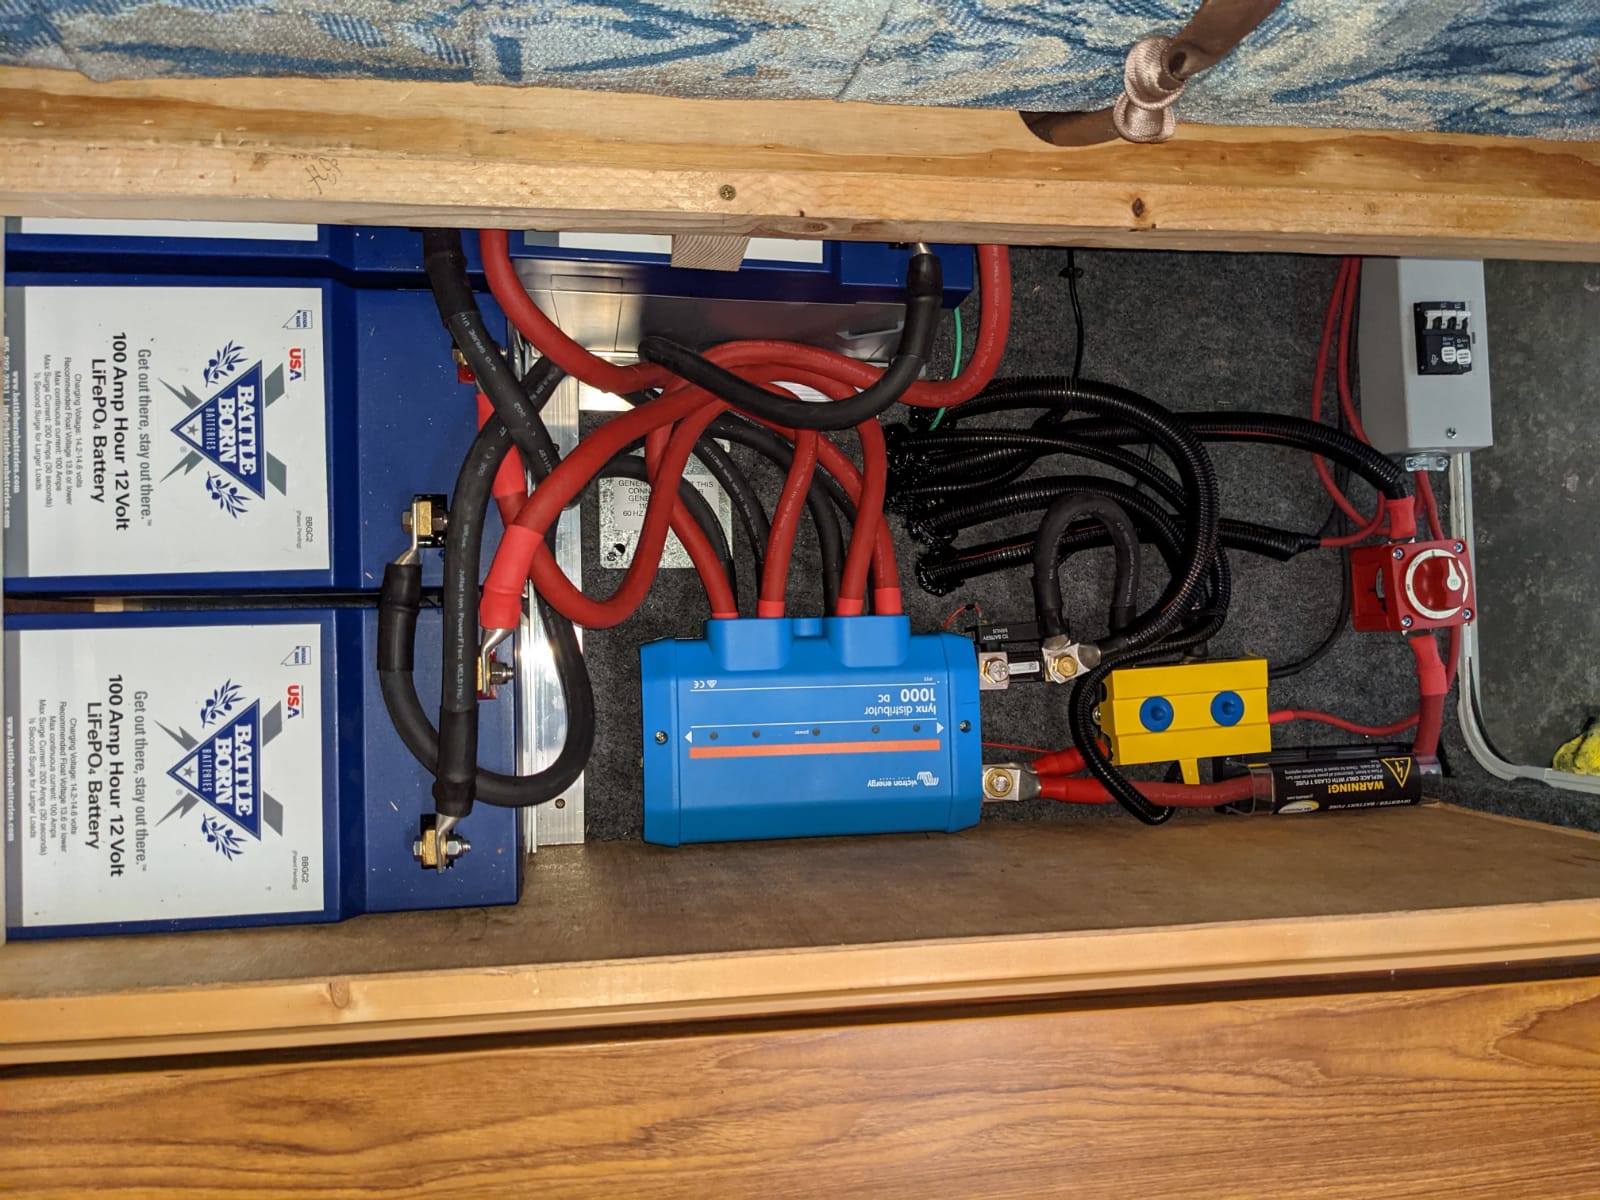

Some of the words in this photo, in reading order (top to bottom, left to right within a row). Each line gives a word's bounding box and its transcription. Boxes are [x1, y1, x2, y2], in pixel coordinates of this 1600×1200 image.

[113, 332, 126, 362] 100
[138, 349, 151, 370] Get
[290, 348, 301, 381] USA
[43, 372, 51, 392] Surge
[110, 367, 127, 411] Amp
[138, 374, 150, 392] out
[33, 410, 41, 430] Surge
[138, 396, 152, 430] there,
[115, 418, 128, 463] Hour
[206, 408, 216, 450] BATTERIES
[219, 397, 236, 463] BORN
[238, 385, 256, 475] BATTLE
[34, 444, 42, 466] Larger
[43, 440, 52, 460] Amps
[64, 433, 72, 457] Voltage
[137, 434, 152, 458] stay
[54, 471, 62, 491] Amps
[91, 436, 106, 503] Battery
[115, 470, 129, 490] 12
[140, 462, 152, 481] out
[116, 493, 130, 530] Volt
[109, 674, 123, 705] 100
[134, 691, 148, 712] Get
[288, 685, 299, 718] USA
[901, 688, 936, 702] 1000
[864, 705, 912, 717] distributor
[916, 703, 936, 715] lynx
[38, 717, 46, 737] Surge
[59, 702, 67, 755] Recommended
[69, 718, 77, 750] Charging
[106, 710, 123, 755] Amp
[135, 716, 146, 735] out
[27, 756, 36, 777] Surge
[134, 739, 148, 774] there,
[202, 749, 212, 791] BATTERIES
[215, 737, 232, 805] BORN
[235, 724, 252, 816] BATTLE
[59, 778, 67, 804] Voltage
[110, 762, 124, 808] Hour
[133, 777, 147, 803] stay
[867, 779, 891, 787] energy
[1328, 780, 1384, 793] WARNING!
[28, 791, 36, 813] Larger
[38, 786, 47, 807] Amps
[86, 781, 102, 849] Battery
[110, 815, 124, 836] 12
[136, 807, 148, 825] out
[49, 818, 57, 838] Amps
[111, 839, 125, 877] Volt
[301, 856, 309, 883] BBGC2
